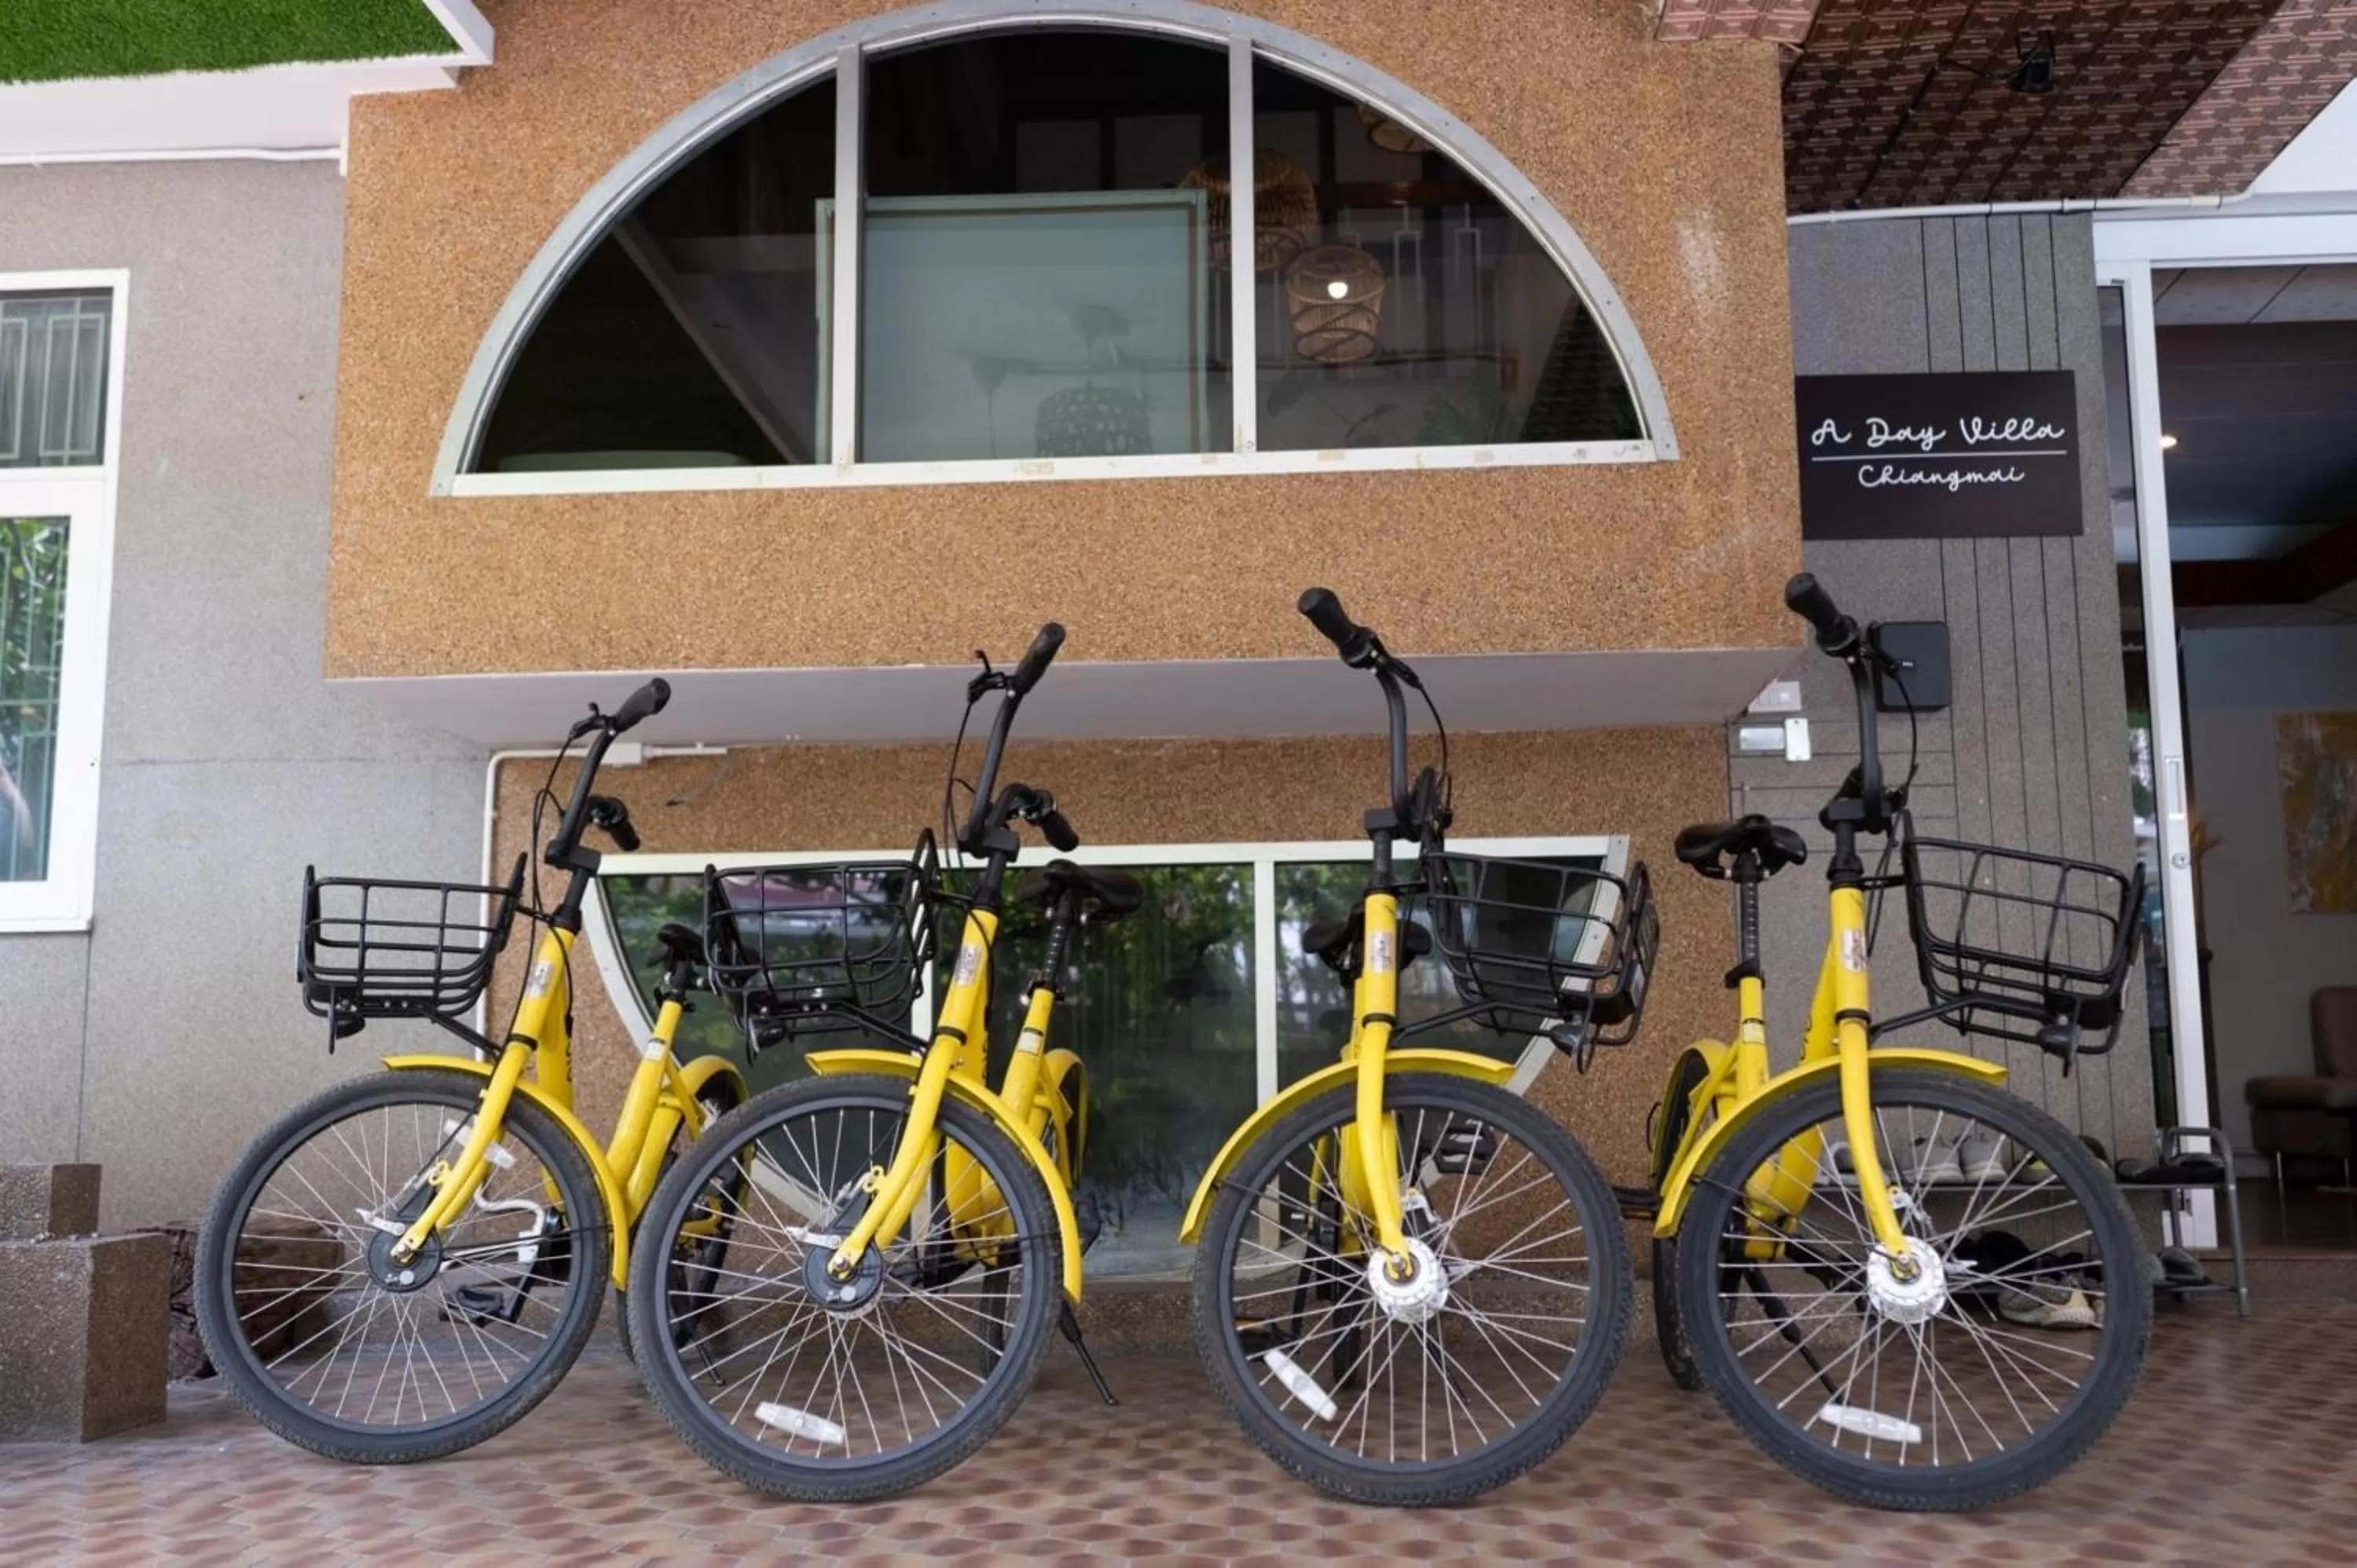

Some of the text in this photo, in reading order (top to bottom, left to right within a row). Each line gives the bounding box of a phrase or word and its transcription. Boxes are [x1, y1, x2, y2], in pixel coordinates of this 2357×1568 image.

[1811, 416, 2066, 452] A Day Villa
[1858, 464, 2025, 492] Chiangmai
